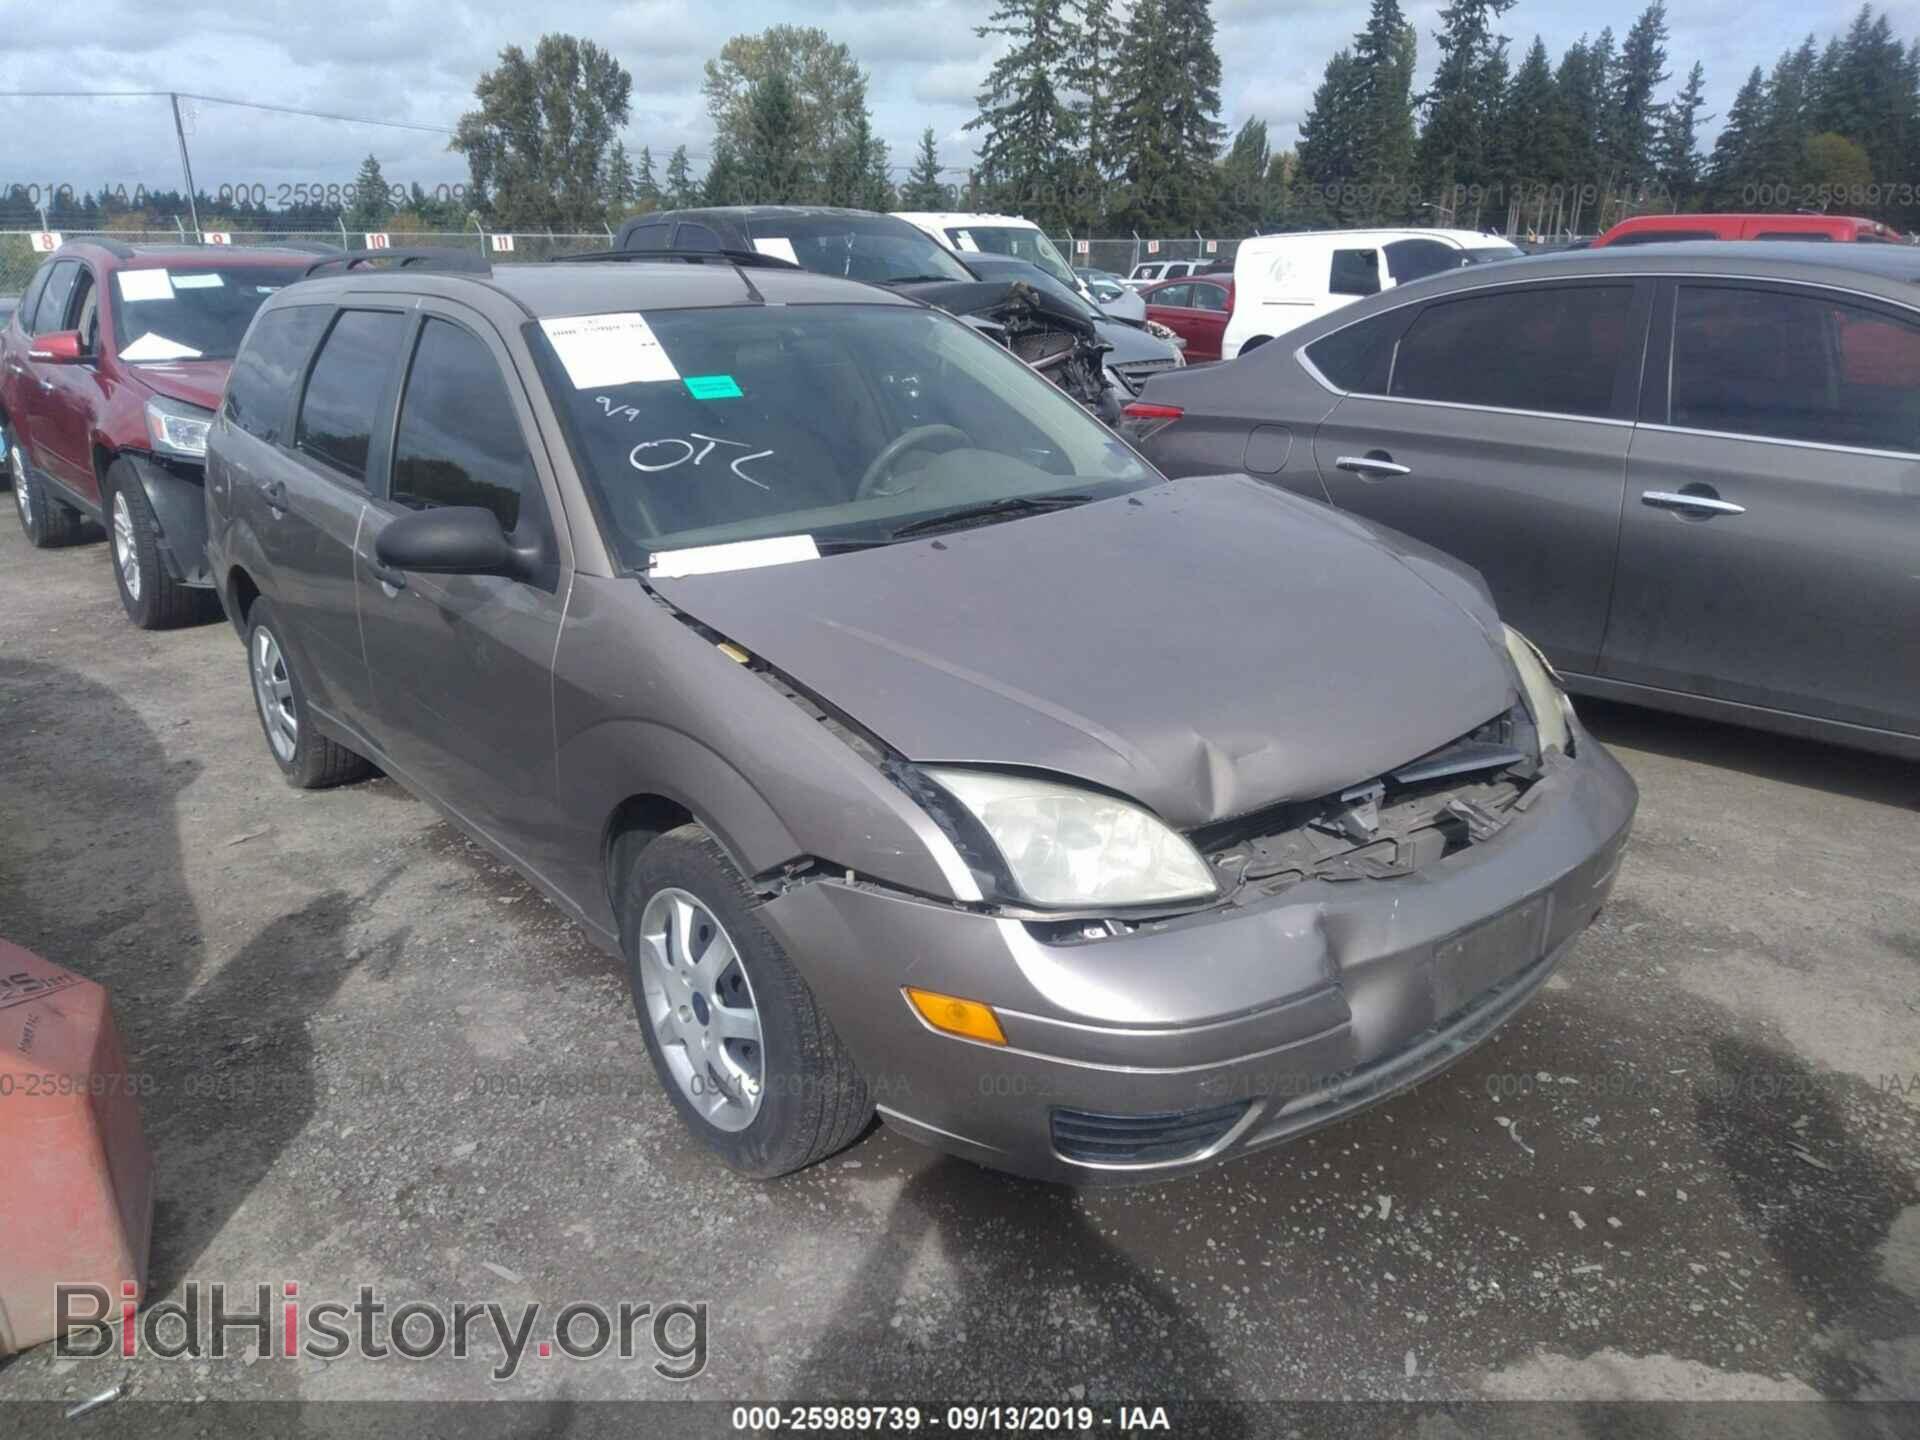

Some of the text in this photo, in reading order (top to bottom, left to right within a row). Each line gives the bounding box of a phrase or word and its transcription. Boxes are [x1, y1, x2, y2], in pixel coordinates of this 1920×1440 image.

[42, 234, 54, 250] 8
[369, 235, 386, 249] 10
[497, 236, 509, 250] 11
